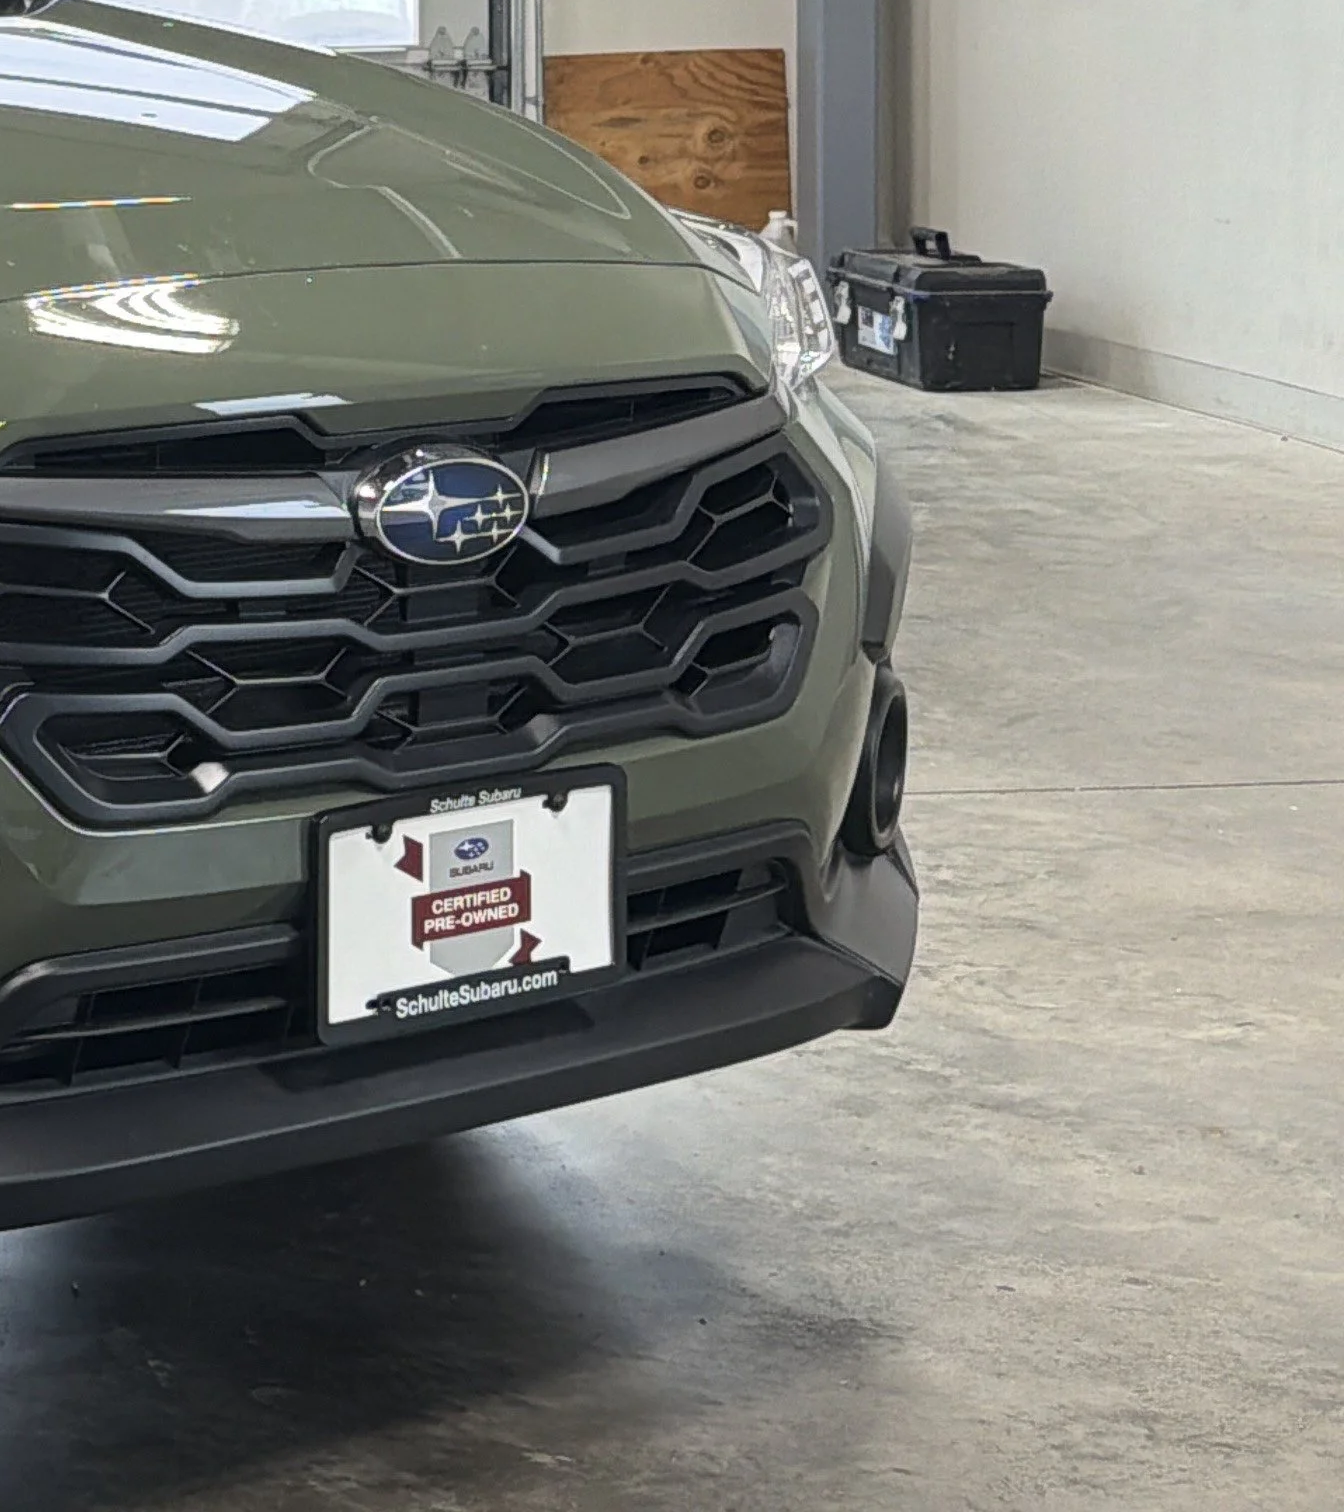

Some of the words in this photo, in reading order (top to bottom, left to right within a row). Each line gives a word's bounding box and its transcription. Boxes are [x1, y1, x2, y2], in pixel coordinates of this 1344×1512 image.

[429, 794, 476, 814] Schulte
[478, 787, 522, 805] Subaru
[449, 860, 494, 878] SUBARU
[431, 886, 512, 915] CERTIFIED
[423, 902, 520, 935] PRE-OWNED
[395, 969, 558, 1019] SchulteSubaru.com
